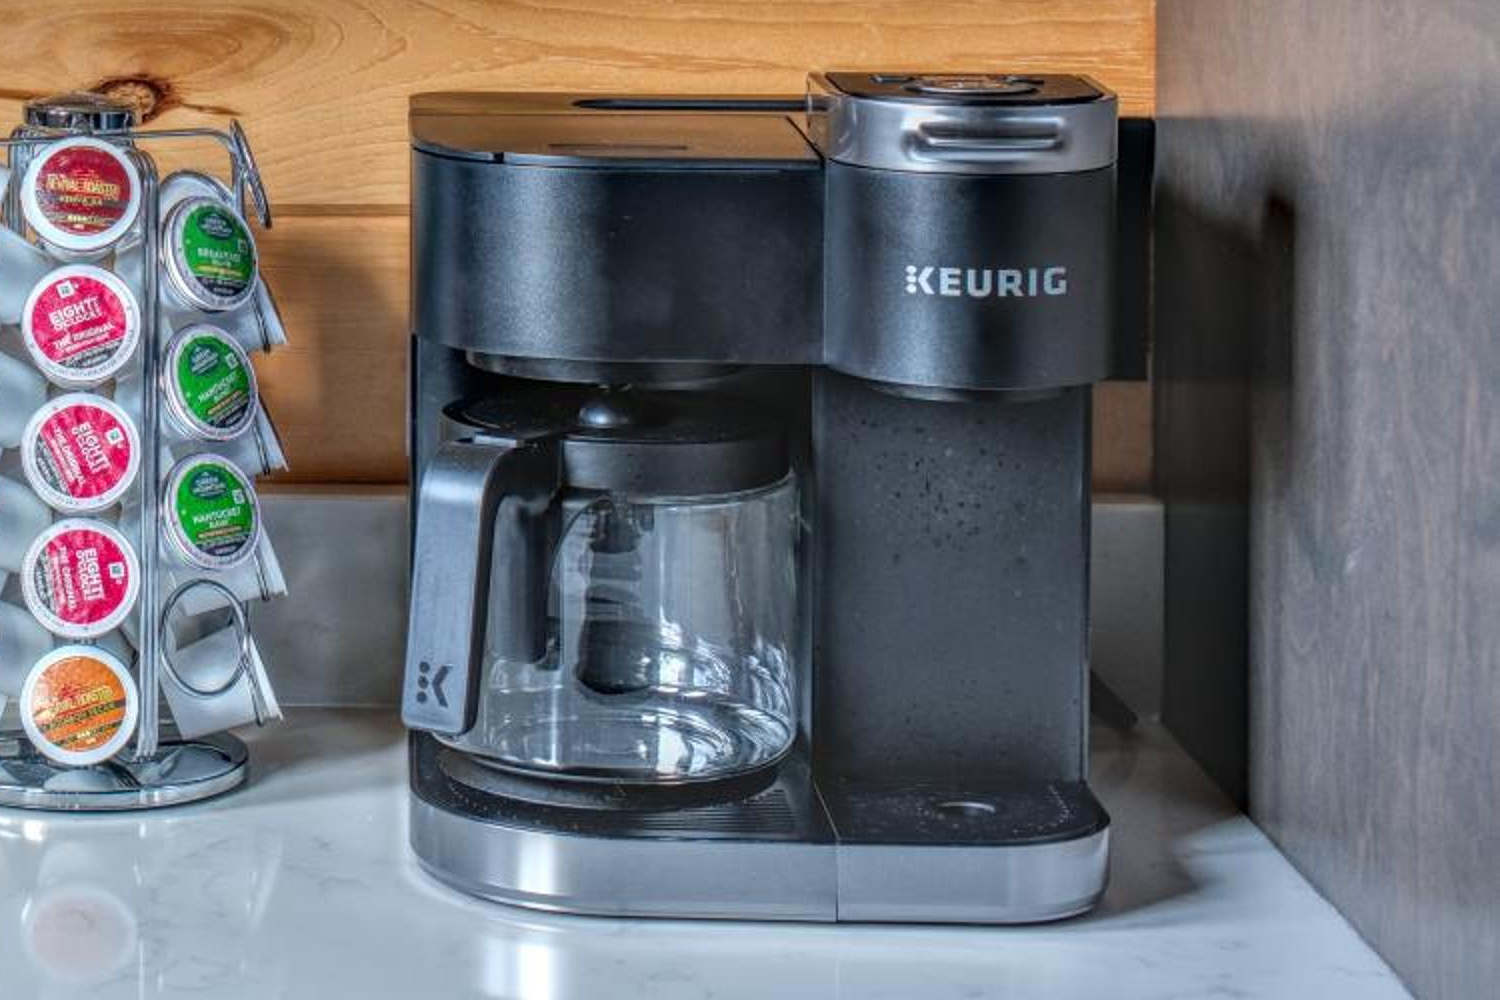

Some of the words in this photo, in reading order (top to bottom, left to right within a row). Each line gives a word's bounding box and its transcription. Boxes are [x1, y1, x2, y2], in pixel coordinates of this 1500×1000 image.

[905, 264, 1068, 298] KEURIG
[49, 297, 102, 323] EIGHT
[81, 422, 111, 474] EIGHT
[84, 547, 105, 600] EIGHT
